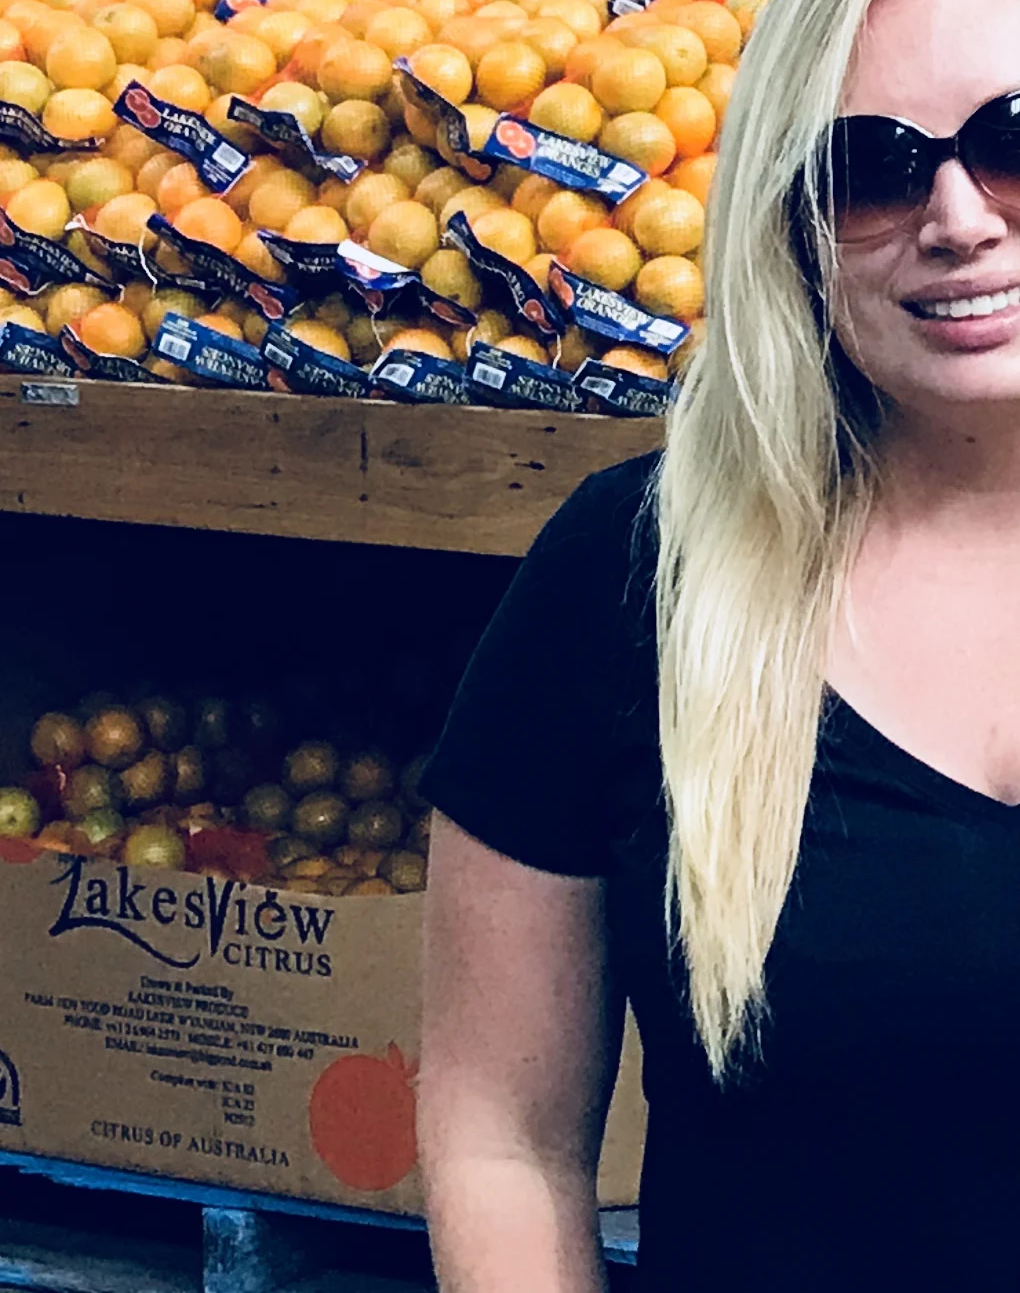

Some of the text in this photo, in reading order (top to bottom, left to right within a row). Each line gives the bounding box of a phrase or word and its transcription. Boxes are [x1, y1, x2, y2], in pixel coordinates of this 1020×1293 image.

[223, 943, 333, 977] CITRUS
[91, 1119, 290, 1168] CITRUS OF AUSTRALIA
